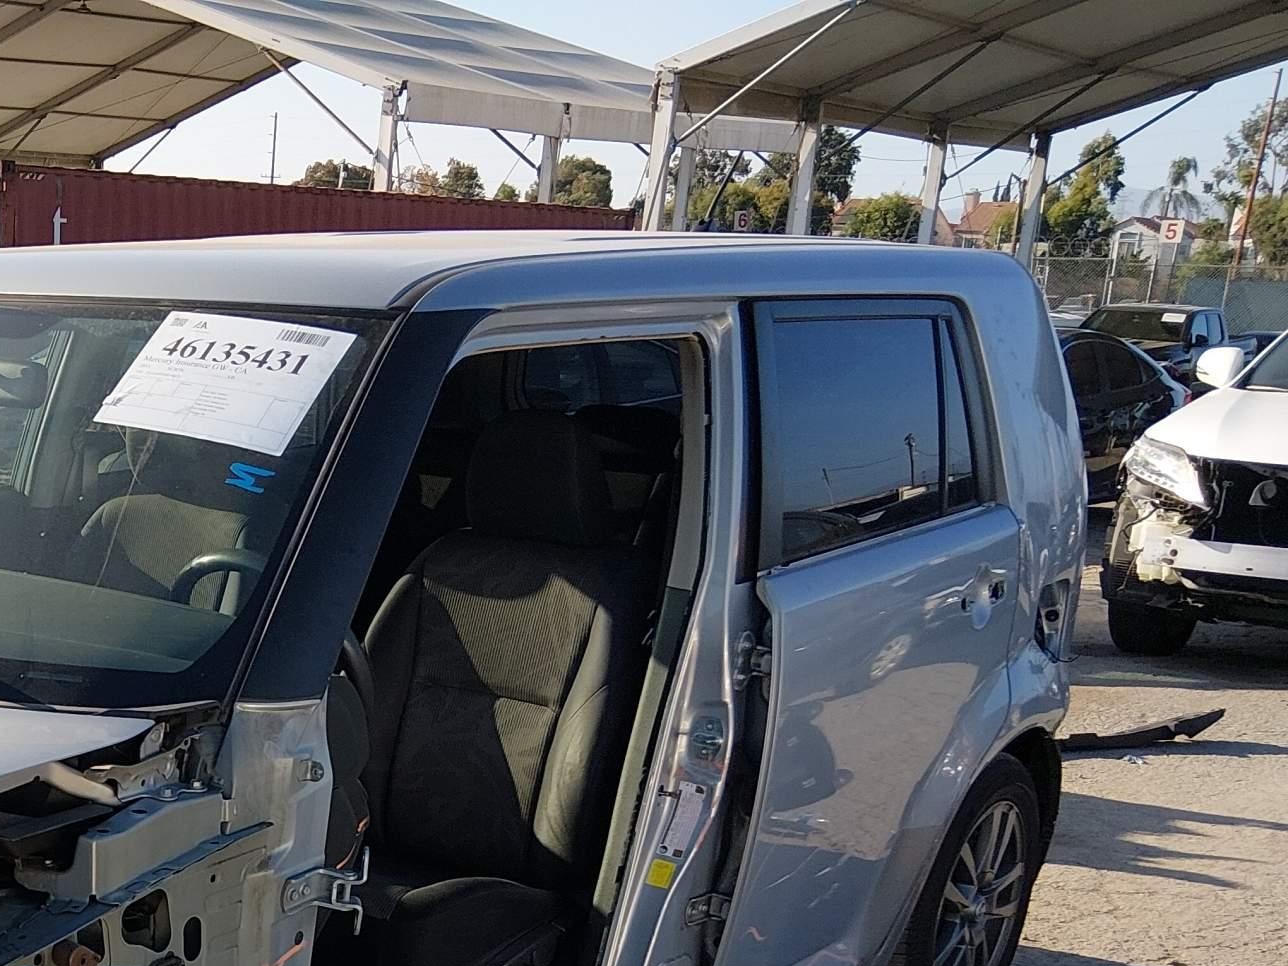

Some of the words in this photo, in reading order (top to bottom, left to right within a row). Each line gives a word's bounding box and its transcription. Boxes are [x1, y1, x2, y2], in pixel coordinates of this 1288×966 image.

[738, 213, 748, 228] 6
[1165, 223, 1178, 240] 5
[162, 336, 310, 376] 46135431
